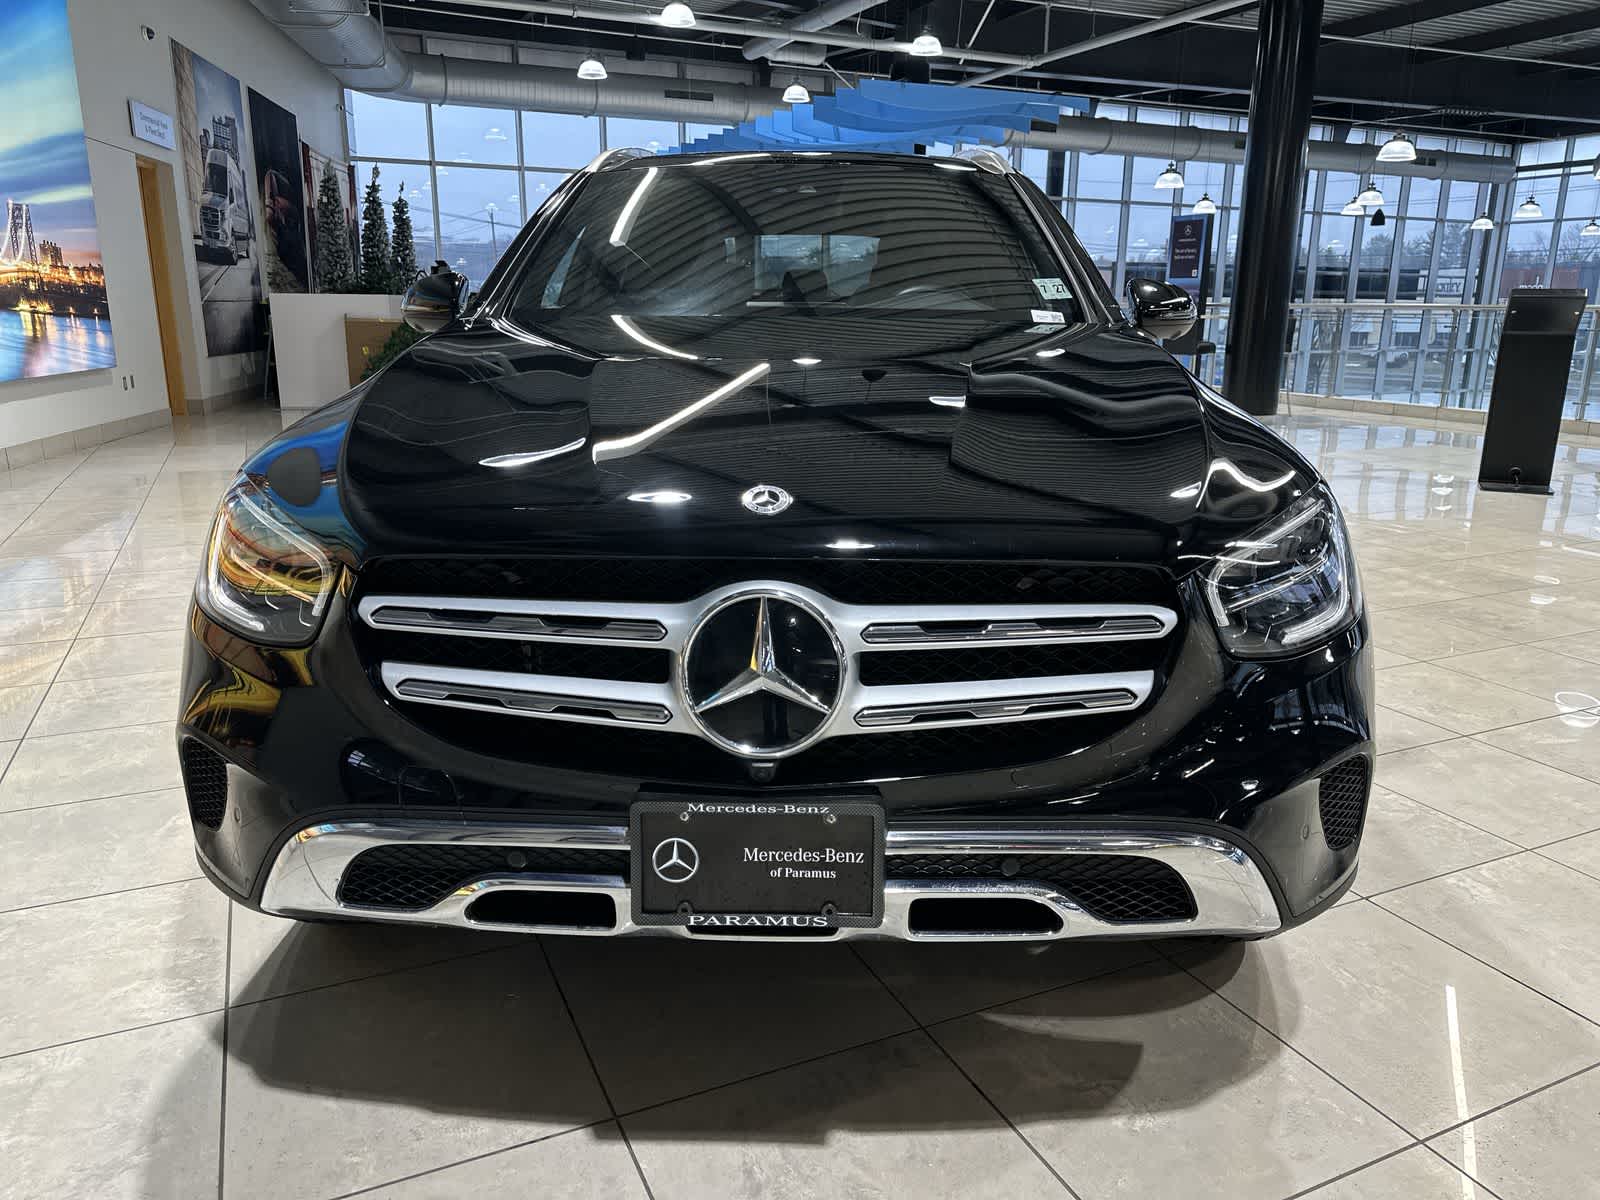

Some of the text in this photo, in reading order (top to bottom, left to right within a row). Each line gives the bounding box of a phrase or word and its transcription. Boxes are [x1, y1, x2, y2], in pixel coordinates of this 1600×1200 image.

[687, 803, 829, 814] Mercedes-Benz
[743, 847, 865, 864] Mercedes-Benz
[769, 867, 837, 879] of Paramus
[688, 915, 829, 927] PARAMUS
